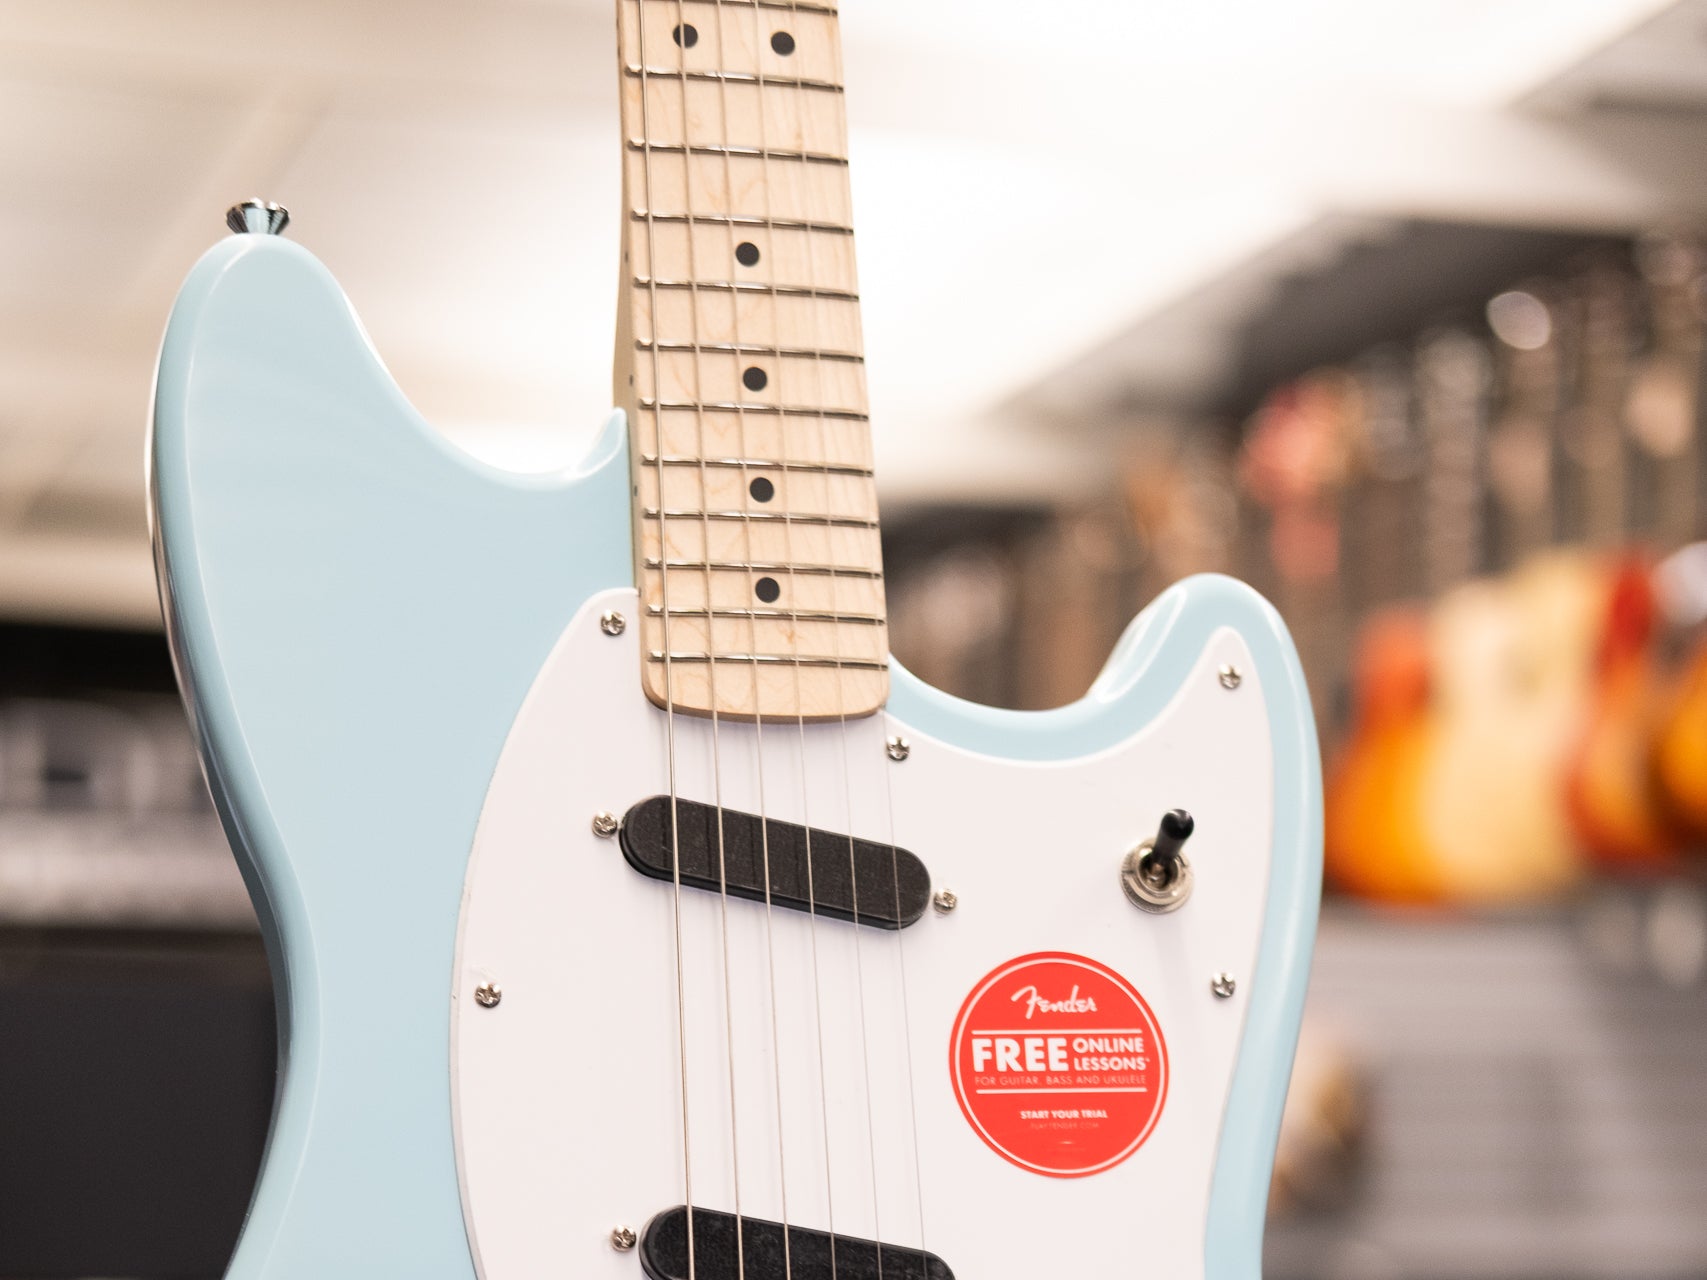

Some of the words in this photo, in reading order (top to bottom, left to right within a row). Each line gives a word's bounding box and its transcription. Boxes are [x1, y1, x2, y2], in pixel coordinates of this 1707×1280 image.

[1010, 984, 1098, 1020] Fender
[1072, 1037, 1145, 1054] ONLINE
[971, 1037, 1070, 1073] FREE
[974, 1075, 996, 1086] FOR
[1046, 1075, 1073, 1086] BASS
[1076, 1074, 1101, 1085] AND
[1103, 1074, 1147, 1085] UKULELE
[1020, 1110, 1049, 1120] START
[1050, 1109, 1080, 1120] YOUR
[1080, 1109, 1108, 1119] TRIAL
